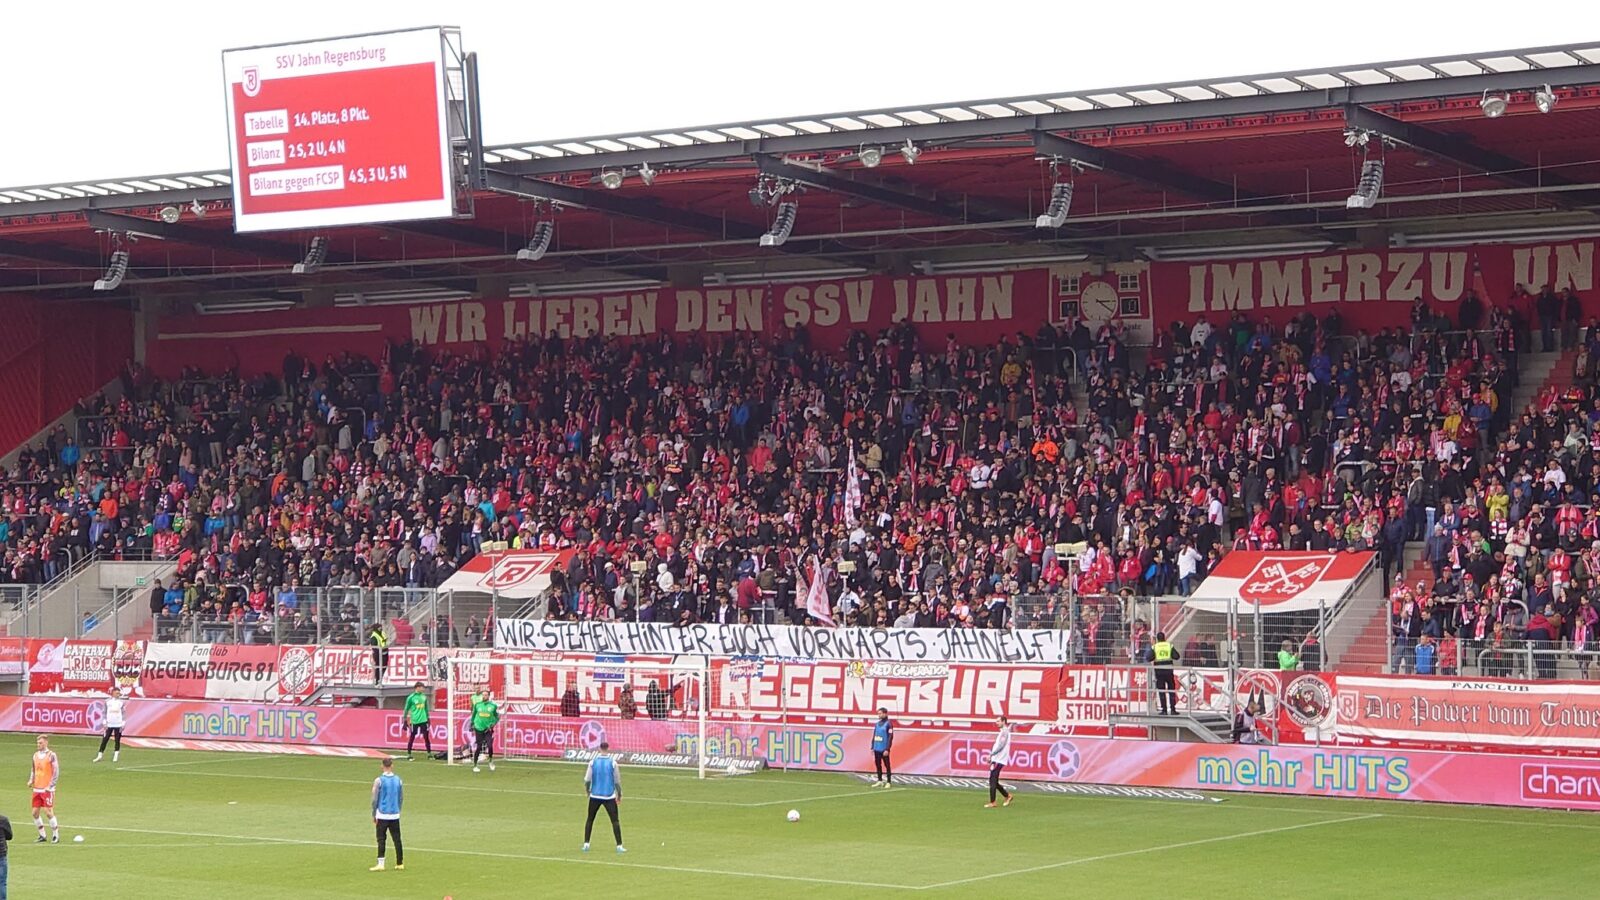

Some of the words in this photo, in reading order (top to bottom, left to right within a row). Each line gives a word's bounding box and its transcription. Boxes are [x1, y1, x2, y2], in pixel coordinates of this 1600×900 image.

[276, 55, 295, 69] SSV
[297, 52, 321, 66] Jahn
[324, 47, 386, 66] Regensburg
[249, 116, 284, 130] Tabelle
[294, 113, 310, 127] 14.
[311, 109, 340, 126] Platz,
[341, 108, 349, 122] 8
[350, 106, 370, 121] Pkt.
[251, 147, 281, 162] Bilanz
[254, 174, 283, 191] Bilanz
[285, 175, 314, 191] gegen
[316, 171, 340, 185] FCSP
[1188, 251, 1468, 313] IMMERZU
[1513, 242, 1595, 296] UN
[409, 302, 487, 344] WIR
[503, 292, 658, 340] LIEBEN
[675, 288, 764, 333] DEN
[784, 279, 874, 328] SSV
[891, 274, 1015, 324] JAHN
[191, 645, 229, 657] Fanclub
[541, 620, 621, 651] STEHEN
[719, 624, 781, 656] EUCH
[787, 626, 928, 660] VORWÄRTS
[143, 659, 252, 681] REGENSBURG
[254, 660, 275, 682] 81
[457, 662, 490, 682] 1889
[869, 664, 892, 675] RED
[892, 663, 949, 676] GENERATION
[720, 662, 1043, 716] REGENSBURG
[1066, 670, 1128, 699] JAHN
[1452, 681, 1530, 692] FANCLUB
[24, 702, 83, 725] charivari
[1363, 694, 1402, 720] Die
[1410, 695, 1481, 727] Power
[1487, 702, 1531, 726] vom
[182, 706, 250, 736] mehr
[257, 710, 318, 740] HITS
[506, 722, 575, 745] charivari
[676, 726, 758, 758] mehr
[767, 730, 843, 765] HITS
[955, 739, 1042, 768] chavari
[630, 753, 690, 764] PANOMERA
[710, 756, 761, 769] Dallmeier
[1198, 749, 1302, 788] mehr
[1313, 752, 1410, 794] HITS
